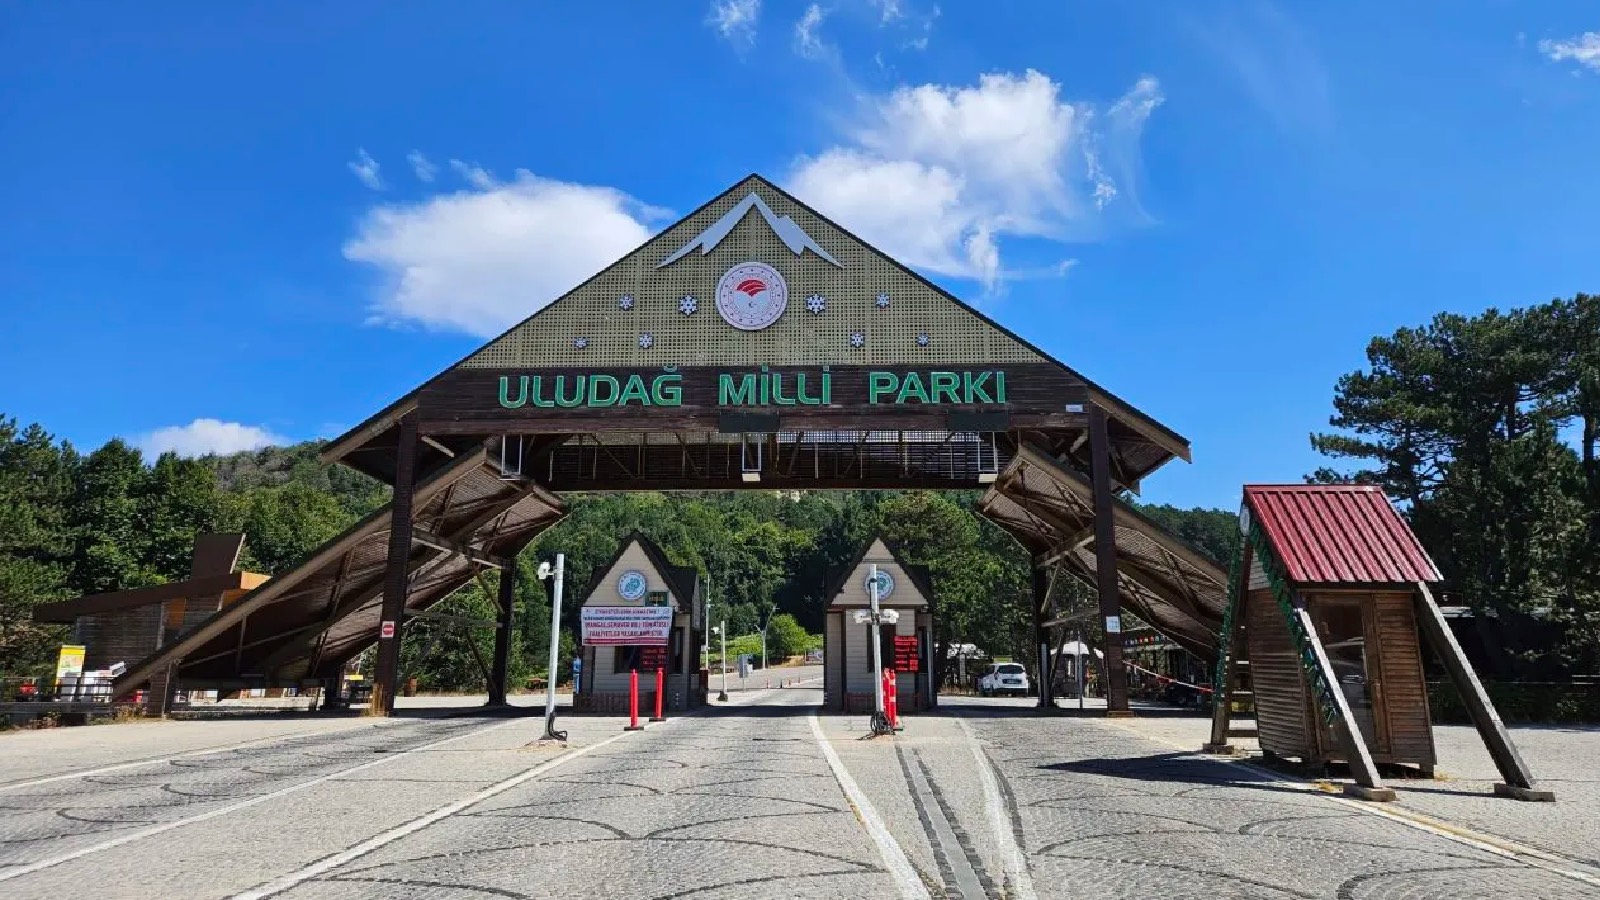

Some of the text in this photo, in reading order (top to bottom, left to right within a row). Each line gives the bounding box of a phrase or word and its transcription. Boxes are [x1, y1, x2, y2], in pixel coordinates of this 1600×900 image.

[499, 364, 1006, 408] ULUDAĞ MİLLİ PARKI
